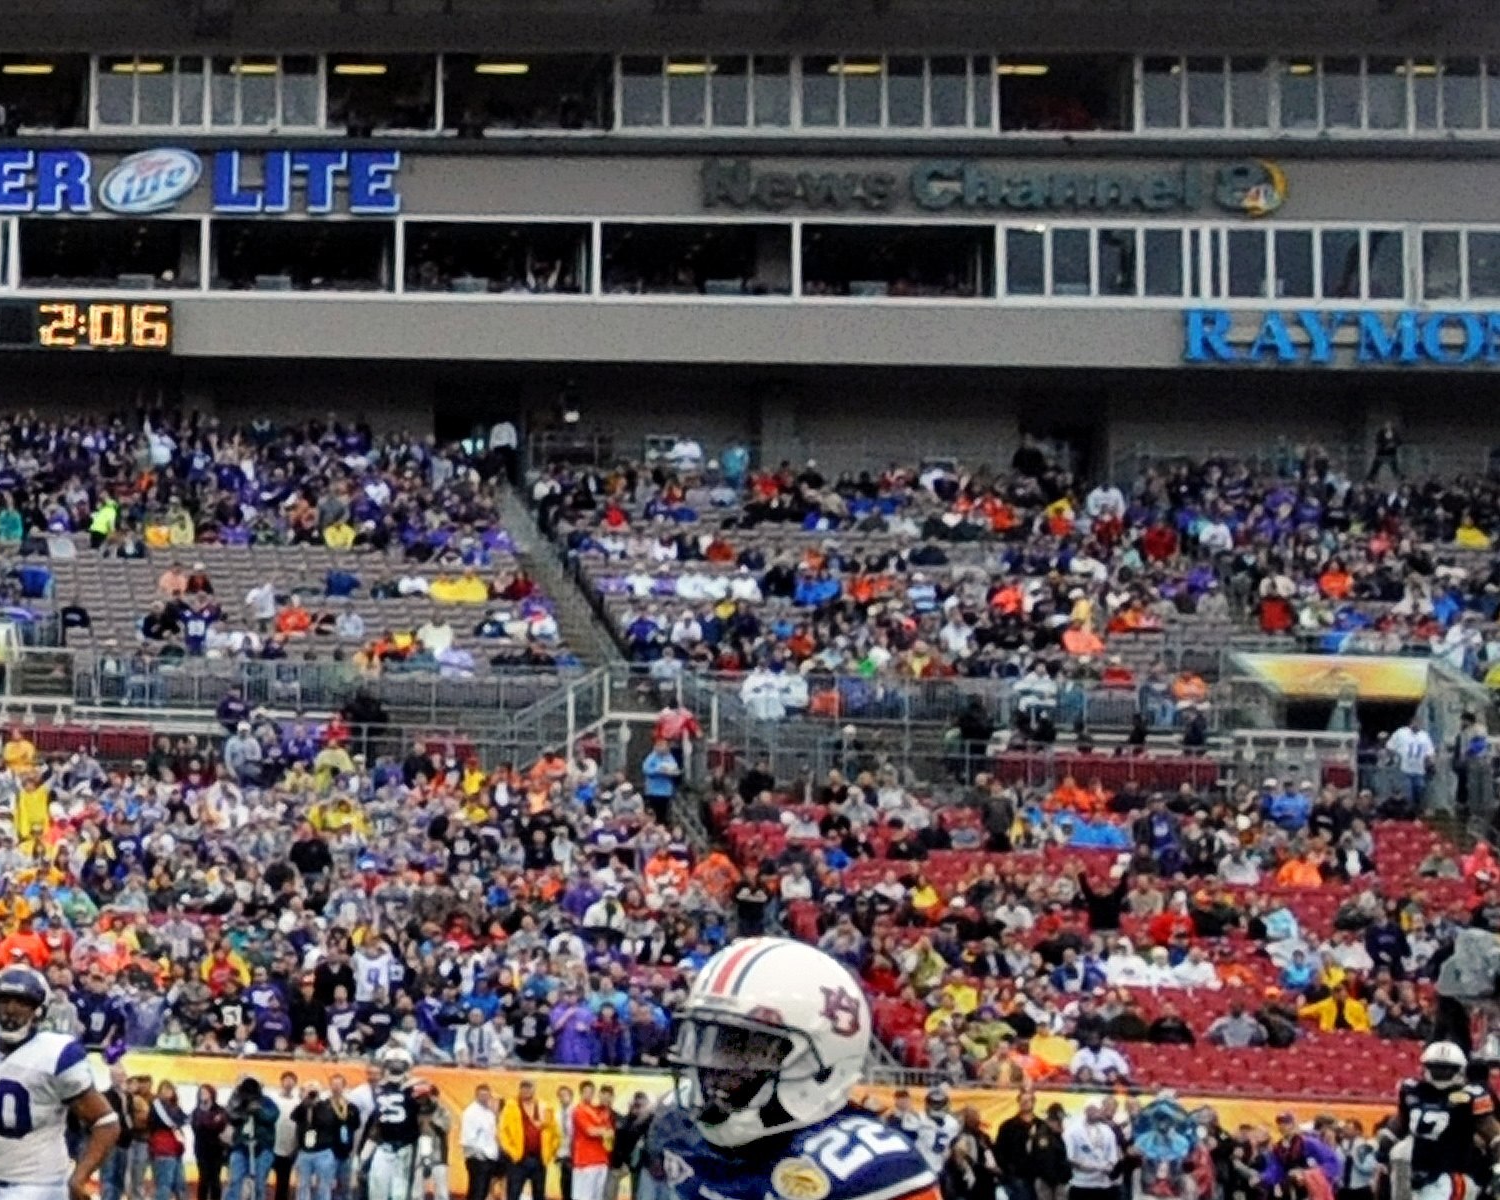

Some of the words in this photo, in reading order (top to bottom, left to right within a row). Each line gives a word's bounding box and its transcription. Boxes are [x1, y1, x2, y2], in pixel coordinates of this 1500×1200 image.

[213, 148, 400, 213] LITE
[701, 158, 897, 209] News
[912, 160, 1201, 210] Channel
[38, 303, 169, 347] 2:06
[1183, 308, 1500, 365] RAYMO
[803, 1116, 911, 1181] 22
